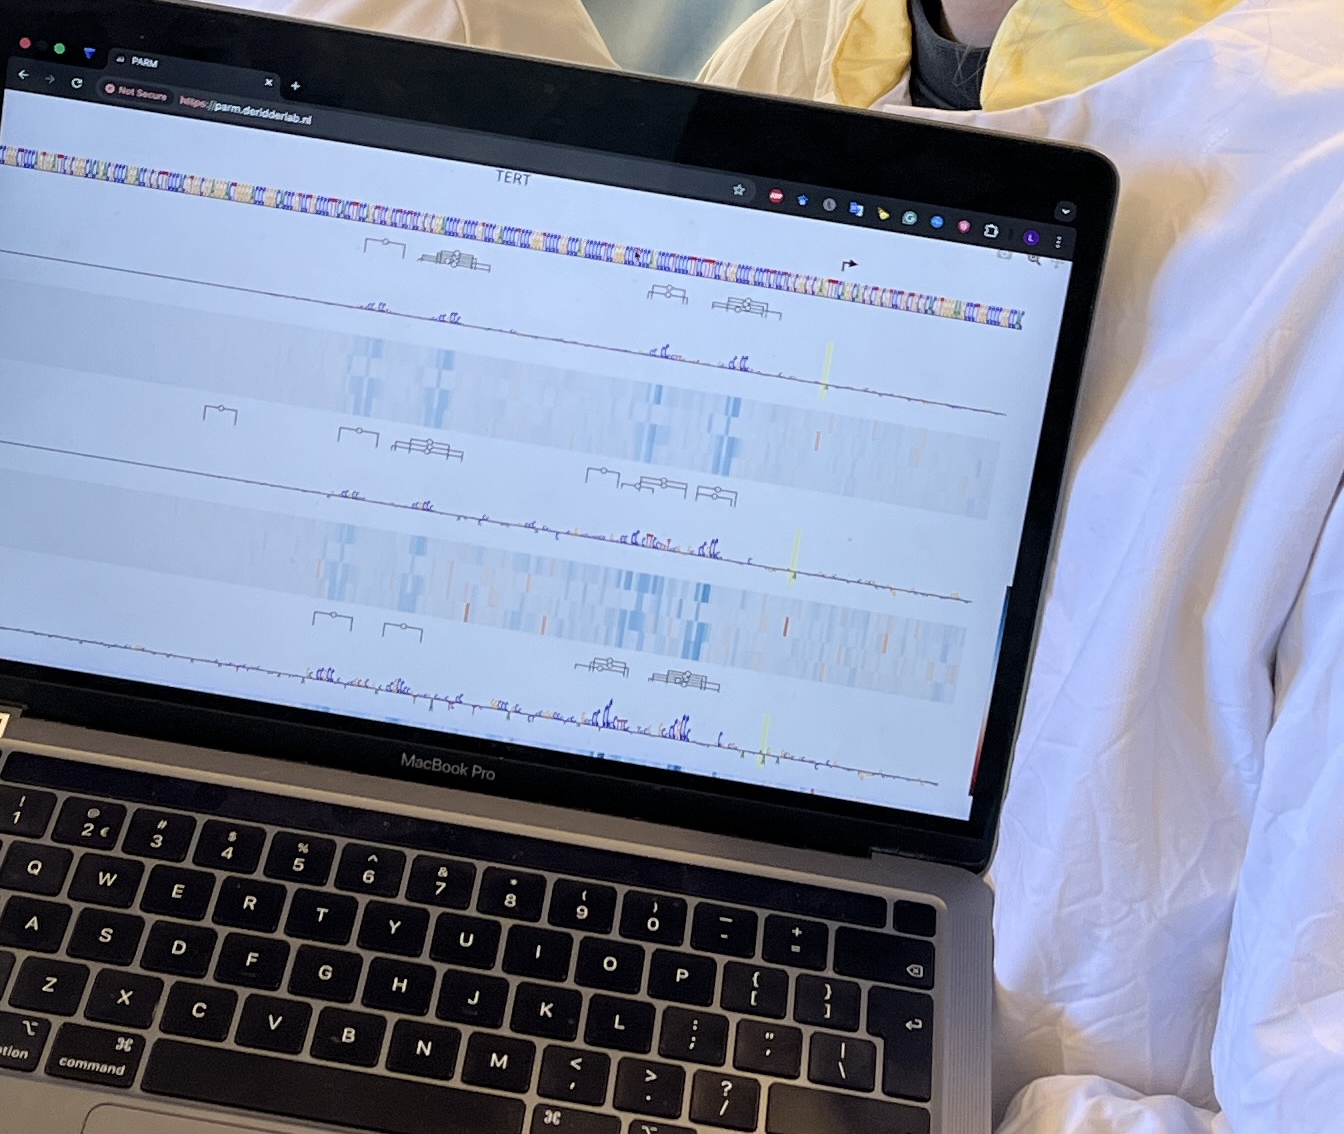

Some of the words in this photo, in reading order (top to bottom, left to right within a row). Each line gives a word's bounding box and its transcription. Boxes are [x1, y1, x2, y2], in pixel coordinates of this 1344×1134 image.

[130, 55, 159, 69] PARM
[117, 85, 135, 97] Not
[136, 88, 168, 102] Secure
[496, 169, 532, 187] TERT
[400, 751, 469, 777] MacBook
[470, 764, 496, 781] Pro
[81, 822, 95, 837] 2
[150, 834, 164, 848] 3
[220, 846, 234, 860] 4
[292, 857, 305, 872] 5
[362, 869, 376, 884] 6
[435, 881, 447, 896] 7
[504, 893, 517, 908] 8
[576, 905, 589, 920] 9
[27, 860, 42, 876] Q
[98, 871, 118, 887] W
[171, 883, 186, 899] E
[242, 895, 257, 911] R
[316, 907, 329, 923] T
[389, 919, 402, 935] Y
[459, 931, 474, 948] U
[603, 956, 618, 972] O
[675, 968, 689, 983] P
[24, 915, 39, 931] A
[98, 927, 114, 943] S
[171, 939, 187, 955] D
[245, 951, 259, 967] F
[318, 964, 333, 981] G
[391, 976, 408, 993] H
[467, 990, 480, 1005] J
[539, 1001, 554, 1018] K
[614, 1014, 625, 1030] L
[41, 976, 58, 993] Z
[116, 989, 134, 1005] X
[191, 1002, 207, 1018] C
[268, 1014, 283, 1030] V
[341, 1027, 356, 1043] B
[416, 1039, 432, 1057] N
[490, 1052, 509, 1070] M
[59, 1057, 126, 1076] command
[721, 1080, 733, 1097] ?
